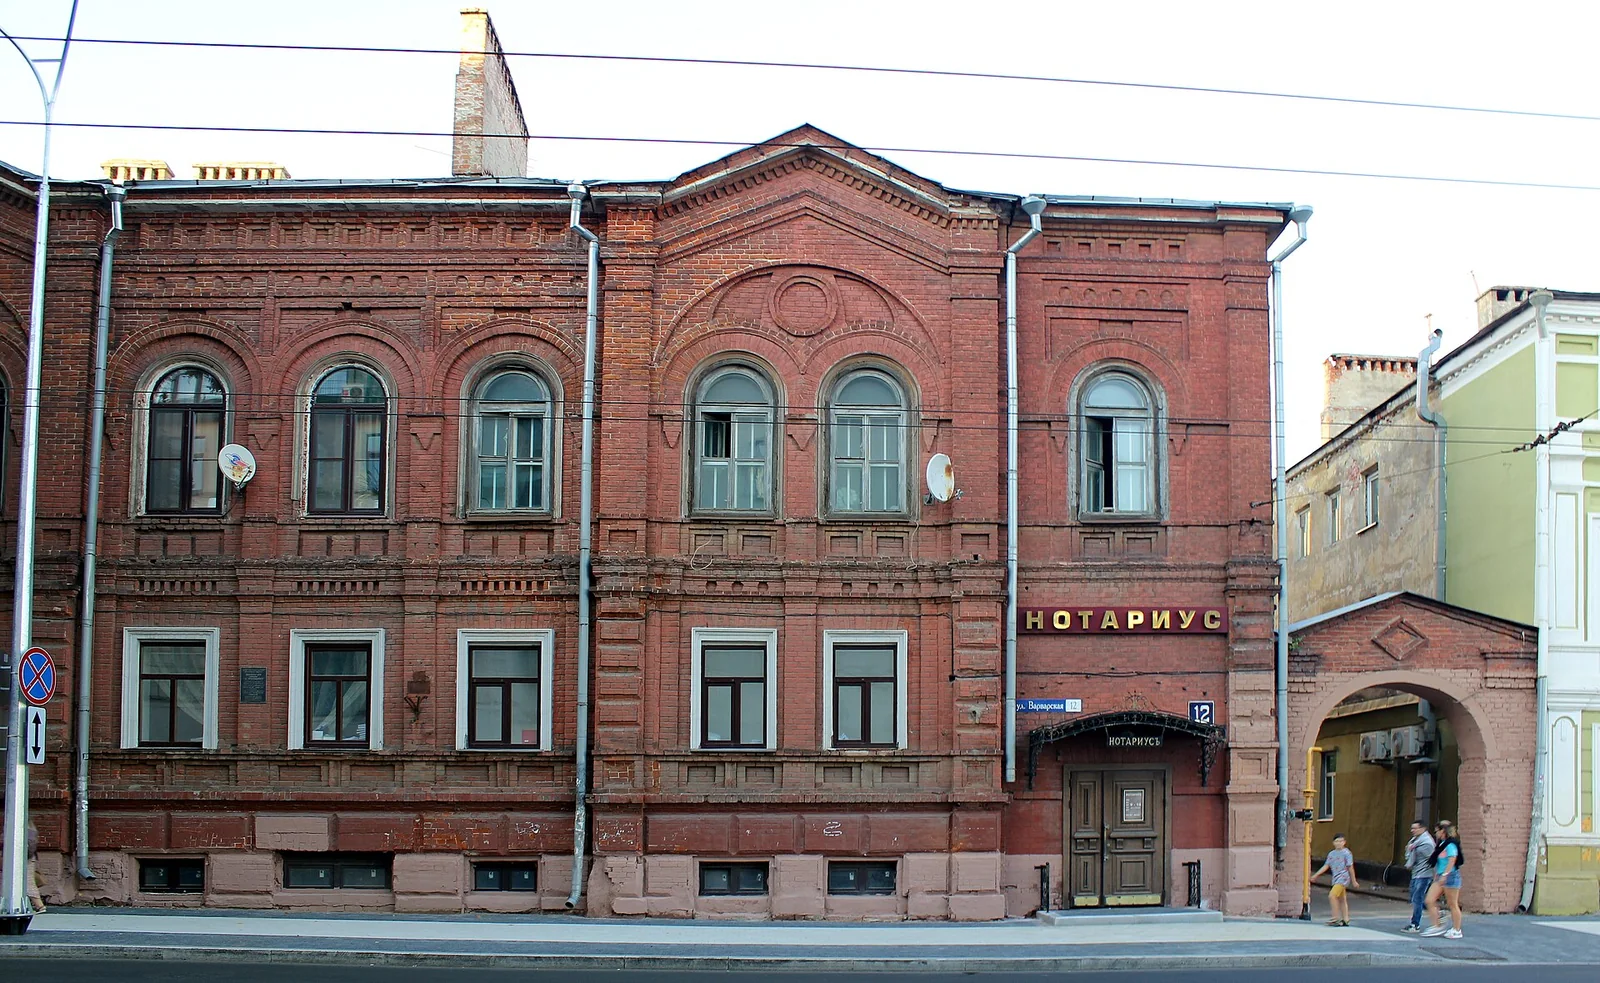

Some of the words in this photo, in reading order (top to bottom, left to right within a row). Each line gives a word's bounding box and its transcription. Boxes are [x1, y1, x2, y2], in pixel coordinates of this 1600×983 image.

[1026, 610, 1221, 630] НОТАРИУС
[1028, 700, 1064, 711] Варварская
[1070, 701, 1077, 710] 12
[1194, 704, 1210, 723] 12
[1108, 736, 1161, 746] НОТАРИУСЪ
